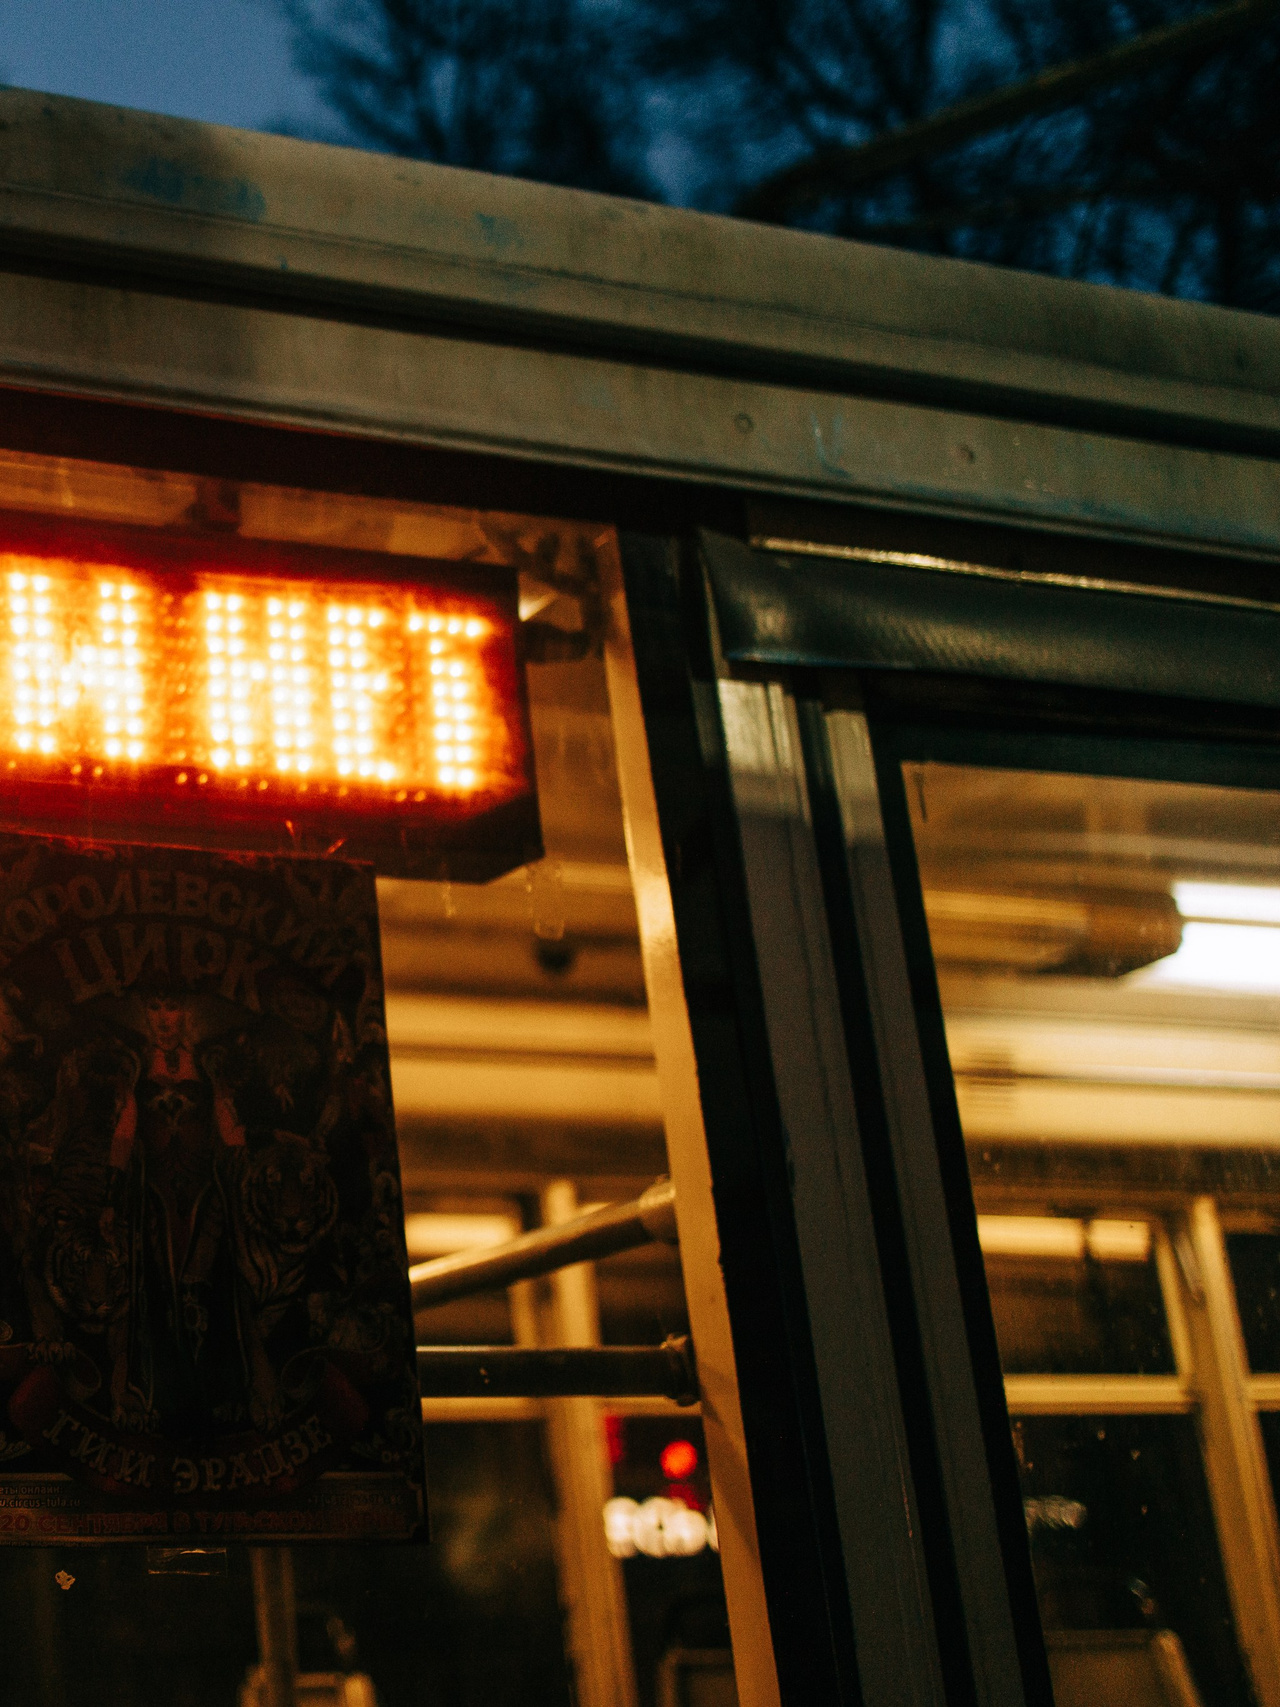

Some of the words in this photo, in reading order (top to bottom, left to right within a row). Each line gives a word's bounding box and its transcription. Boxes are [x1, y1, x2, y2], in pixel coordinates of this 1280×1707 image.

[194, 572, 505, 795] НЕТ
[53, 920, 277, 1010] ЦИРК
[171, 1414, 335, 1494] ЭРАДЗЕ
[0, 1513, 30, 1533] 20
[37, 1511, 168, 1534] СЕНТЯБРЯ
